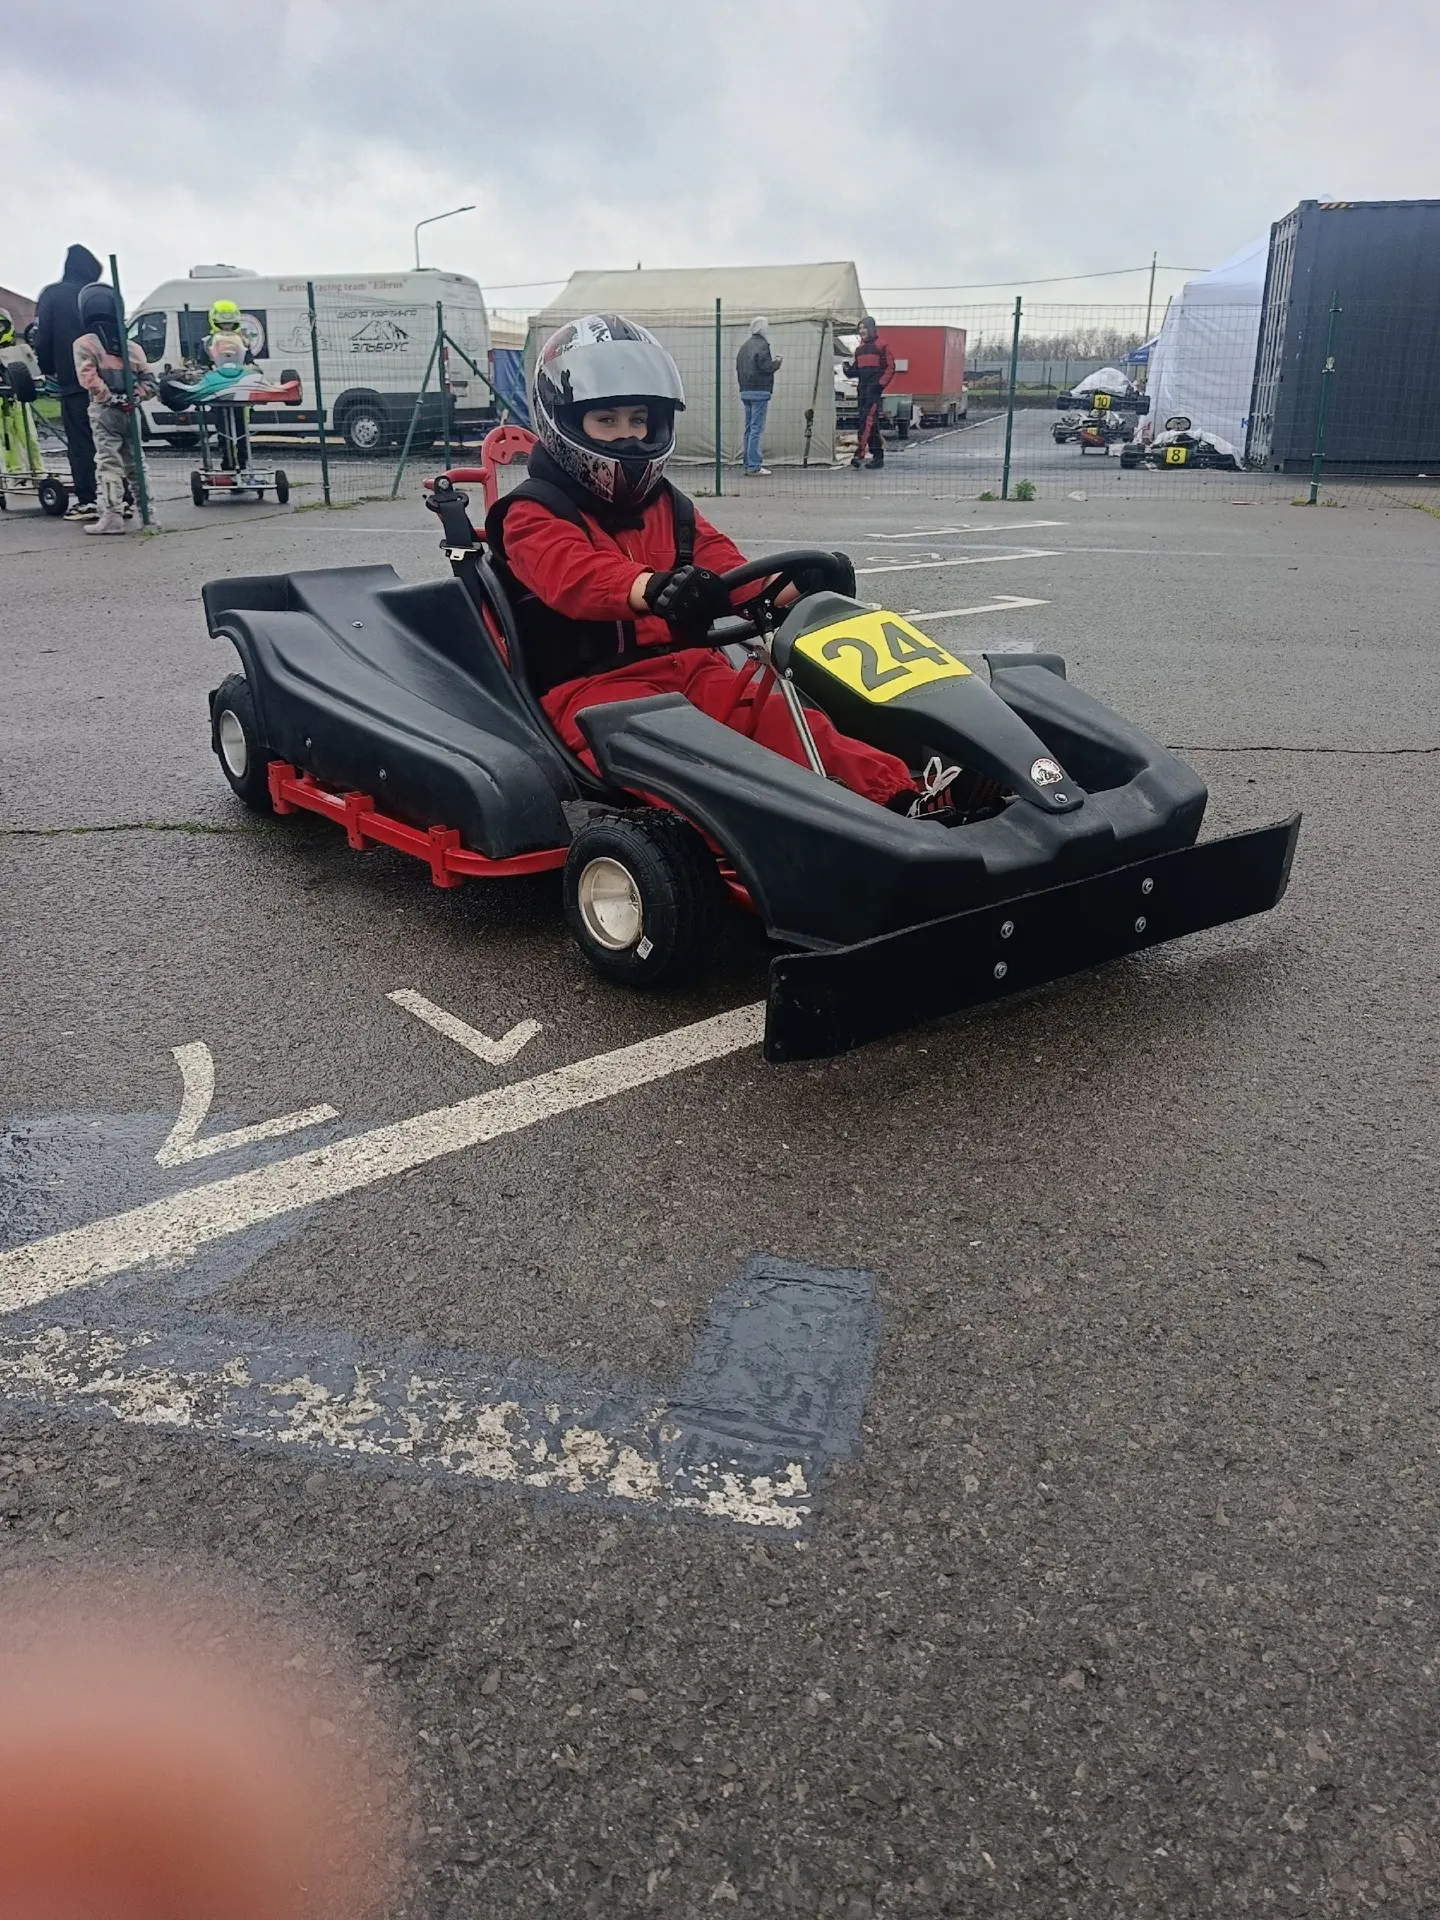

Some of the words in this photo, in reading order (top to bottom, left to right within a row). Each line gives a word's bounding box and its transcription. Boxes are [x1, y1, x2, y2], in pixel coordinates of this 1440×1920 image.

[278, 283, 311, 293] Kartin
[344, 283, 367, 291] team
[349, 342, 409, 354] ЭЛЬБРУС
[1095, 396, 1109, 408] 10
[1171, 449, 1181, 462] 8
[821, 621, 950, 692] 24
